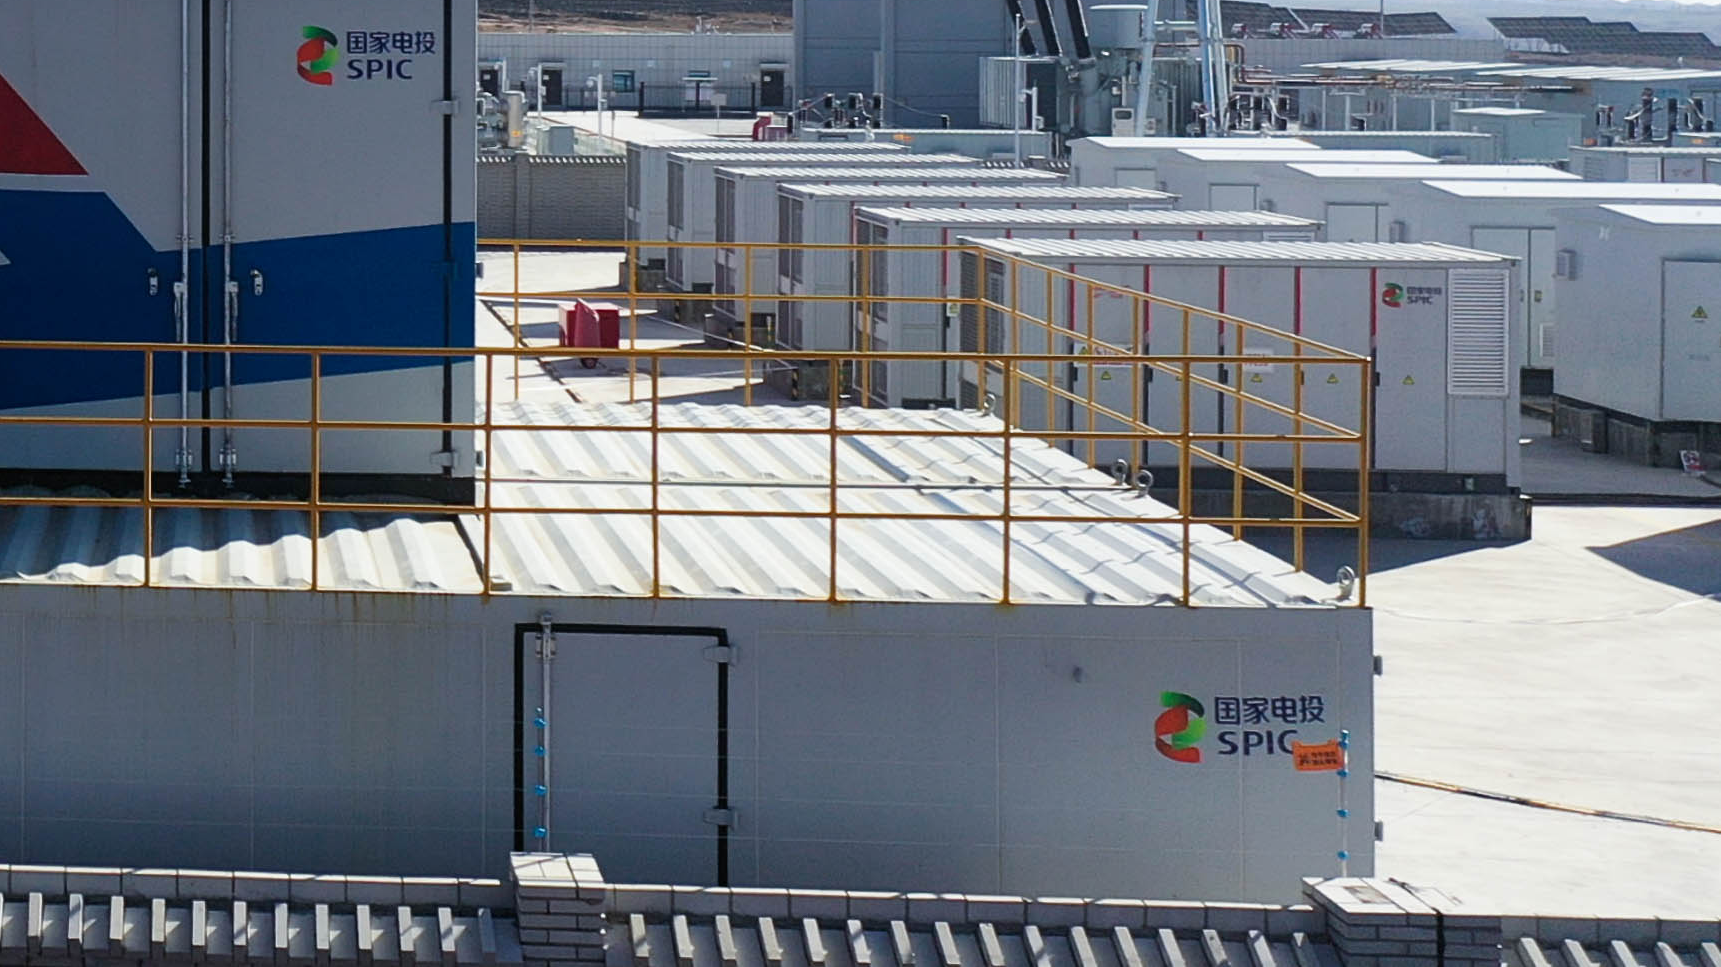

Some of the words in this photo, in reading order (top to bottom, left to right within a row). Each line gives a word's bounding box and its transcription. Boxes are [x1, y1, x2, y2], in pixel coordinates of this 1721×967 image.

[346, 31, 436, 54] 国家电投
[346, 59, 413, 80] SPIC
[1214, 696, 1325, 725] 国家电投
[1217, 730, 1299, 756] SPIC
